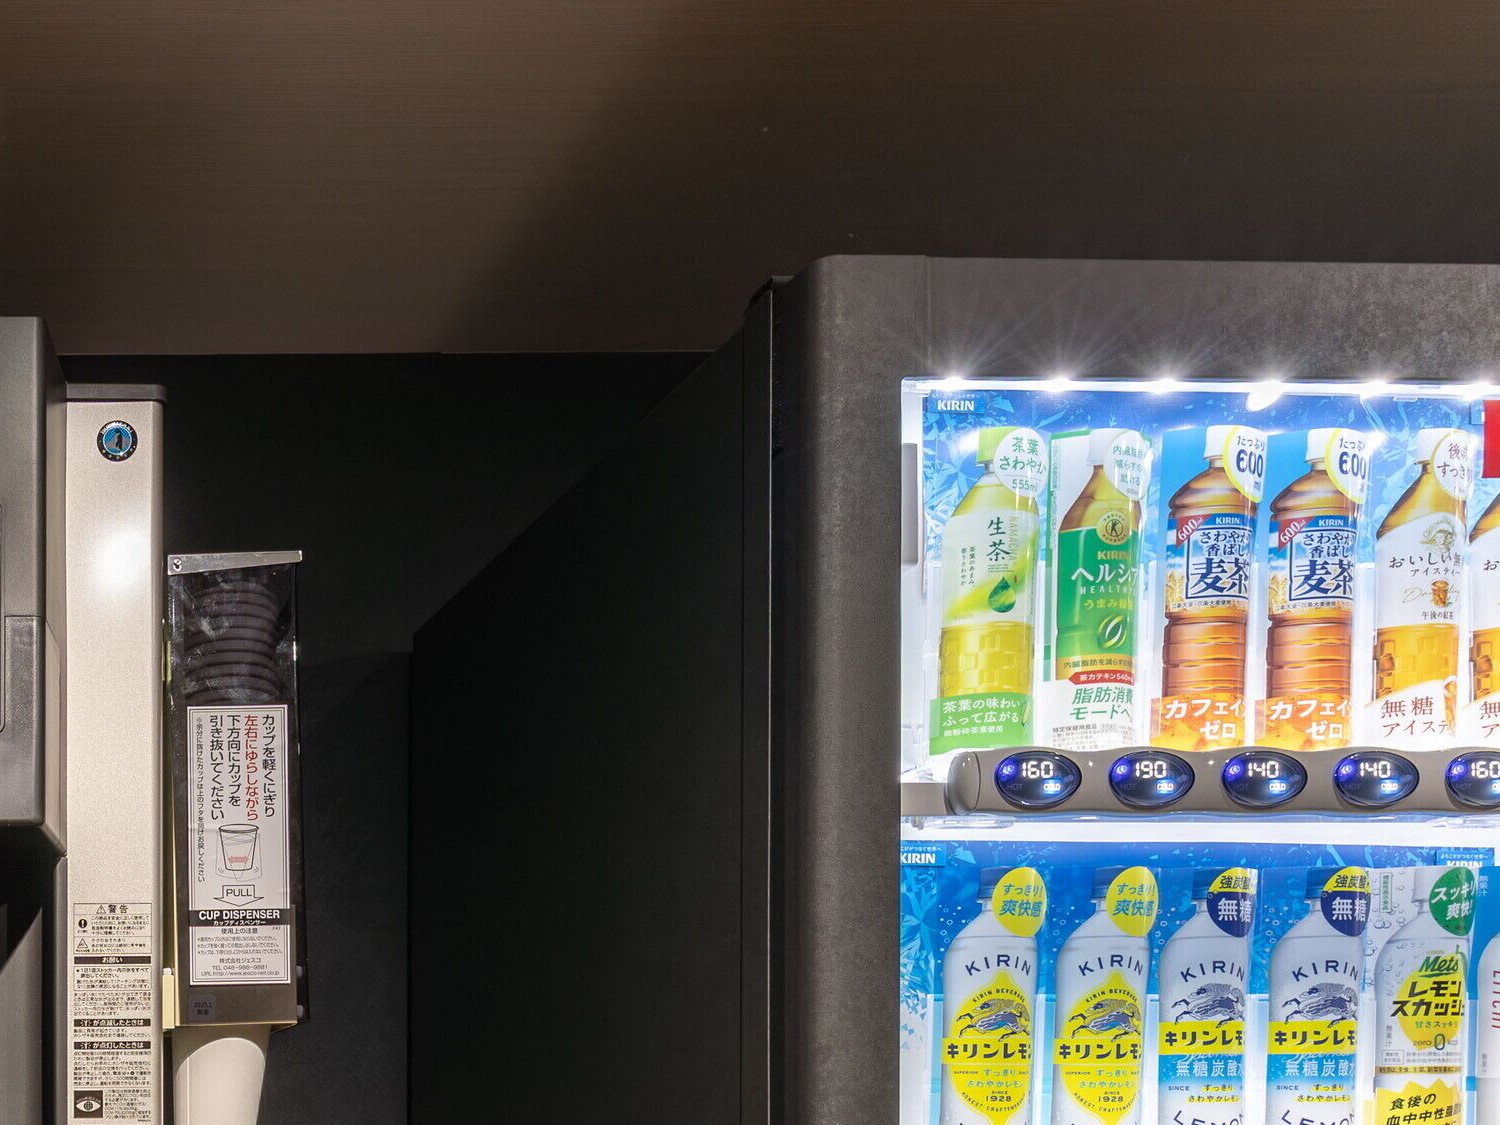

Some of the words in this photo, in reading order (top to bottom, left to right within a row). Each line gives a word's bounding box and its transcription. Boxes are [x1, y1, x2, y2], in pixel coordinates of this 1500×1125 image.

[937, 400, 975, 411] KIRIN
[1012, 436, 1039, 456] 茶葉
[999, 456, 1047, 475] さわやか
[1235, 449, 1264, 478] 600
[1338, 451, 1366, 480] 600
[1215, 516, 1241, 525] KIRIN
[1318, 519, 1344, 527] KIRIN
[986, 516, 1011, 562] 生茶
[1190, 557, 1249, 596] 麦茶
[1294, 559, 1353, 597] 麦茶
[942, 697, 1020, 714] 茶葉の味わい
[1381, 696, 1434, 719] 無糖
[1200, 720, 1237, 741] ゼロ
[1306, 720, 1343, 741] ゼロ
[209, 715, 224, 820] 引き抜いてください
[227, 714, 241, 807] 下方向にカップを
[244, 714, 259, 821] 左右にゆらしながら
[262, 714, 277, 818] カップを軽くにぎり
[1021, 761, 1054, 779] 160
[1135, 761, 1167, 779] 190
[1248, 761, 1279, 779] 140
[1360, 761, 1391, 779] 140
[1471, 761, 1500, 779] 160
[226, 888, 253, 897] PULL
[199, 910, 220, 920] CUP
[222, 909, 280, 920] DISPENSER
[999, 899, 1043, 918] 爽快感
[1112, 899, 1155, 917] 爽快感
[1218, 898, 1252, 923] 無糖
[1332, 896, 1367, 922] 無糖
[965, 954, 1031, 976] KIRIN
[1077, 954, 1144, 977] KIRIN
[1180, 960, 1245, 983] KIRIN
[1291, 960, 1359, 982] KIRIN
[1419, 956, 1459, 972] Mets
[1408, 980, 1462, 998] レモン
[983, 1069, 1016, 1077] すっきり
[1096, 1069, 1128, 1078] すっきり
[1204, 1083, 1233, 1092] すっきり
[1313, 1083, 1344, 1092] すっきり
[1098, 1095, 1124, 1103] 1928
[1389, 1093, 1437, 1111] 食後の
